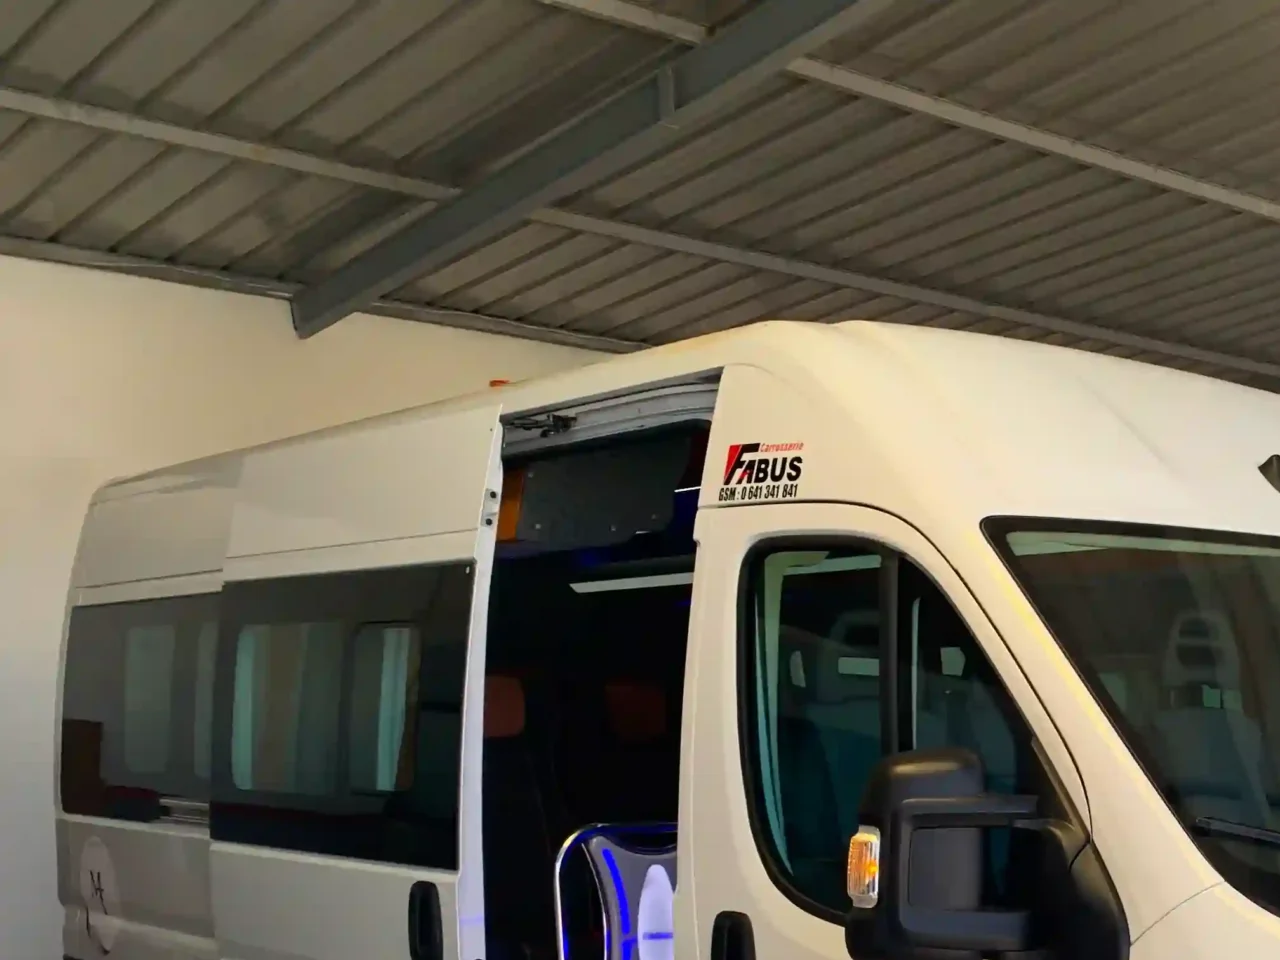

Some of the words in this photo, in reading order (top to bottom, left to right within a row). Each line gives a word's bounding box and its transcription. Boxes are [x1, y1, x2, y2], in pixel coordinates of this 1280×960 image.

[760, 442, 804, 453] Carrosserie
[723, 443, 803, 486] FABUS
[718, 487, 737, 501] GSM
[748, 485, 762, 500] 641
[764, 484, 780, 499] 341
[782, 483, 798, 498] 841
